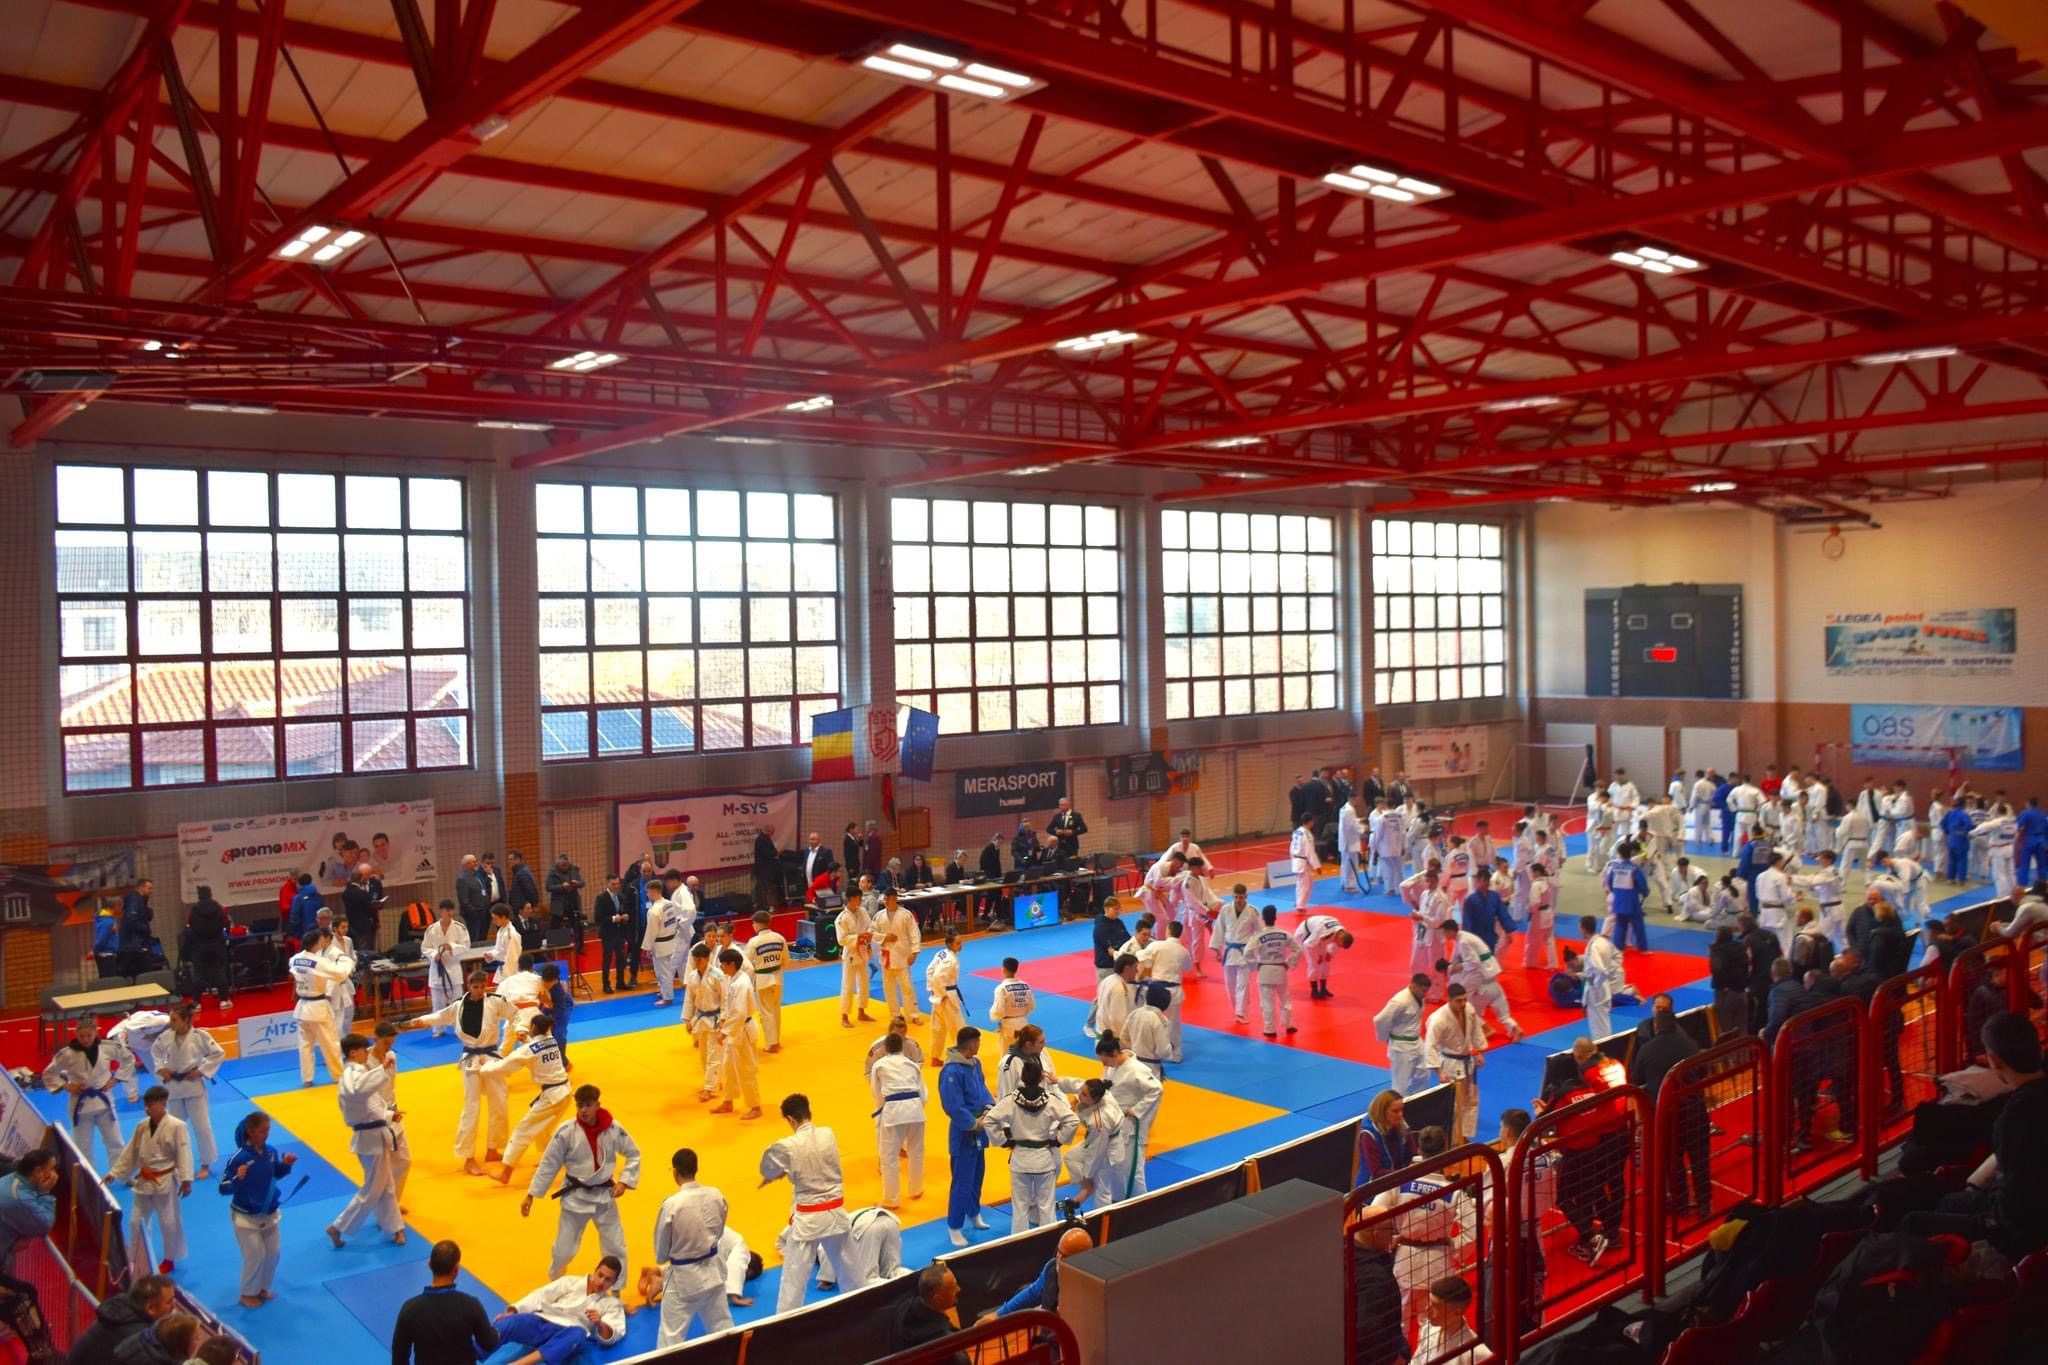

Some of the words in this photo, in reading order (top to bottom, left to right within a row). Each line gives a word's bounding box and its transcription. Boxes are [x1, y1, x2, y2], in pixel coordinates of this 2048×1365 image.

[1884, 611, 1924, 625] point
[1862, 712, 1914, 737] oas
[964, 771, 1057, 794] MERASPORT
[723, 802, 768, 816] M-SYS
[763, 953, 781, 964] ROU
[265, 1021, 298, 1037] MTS
